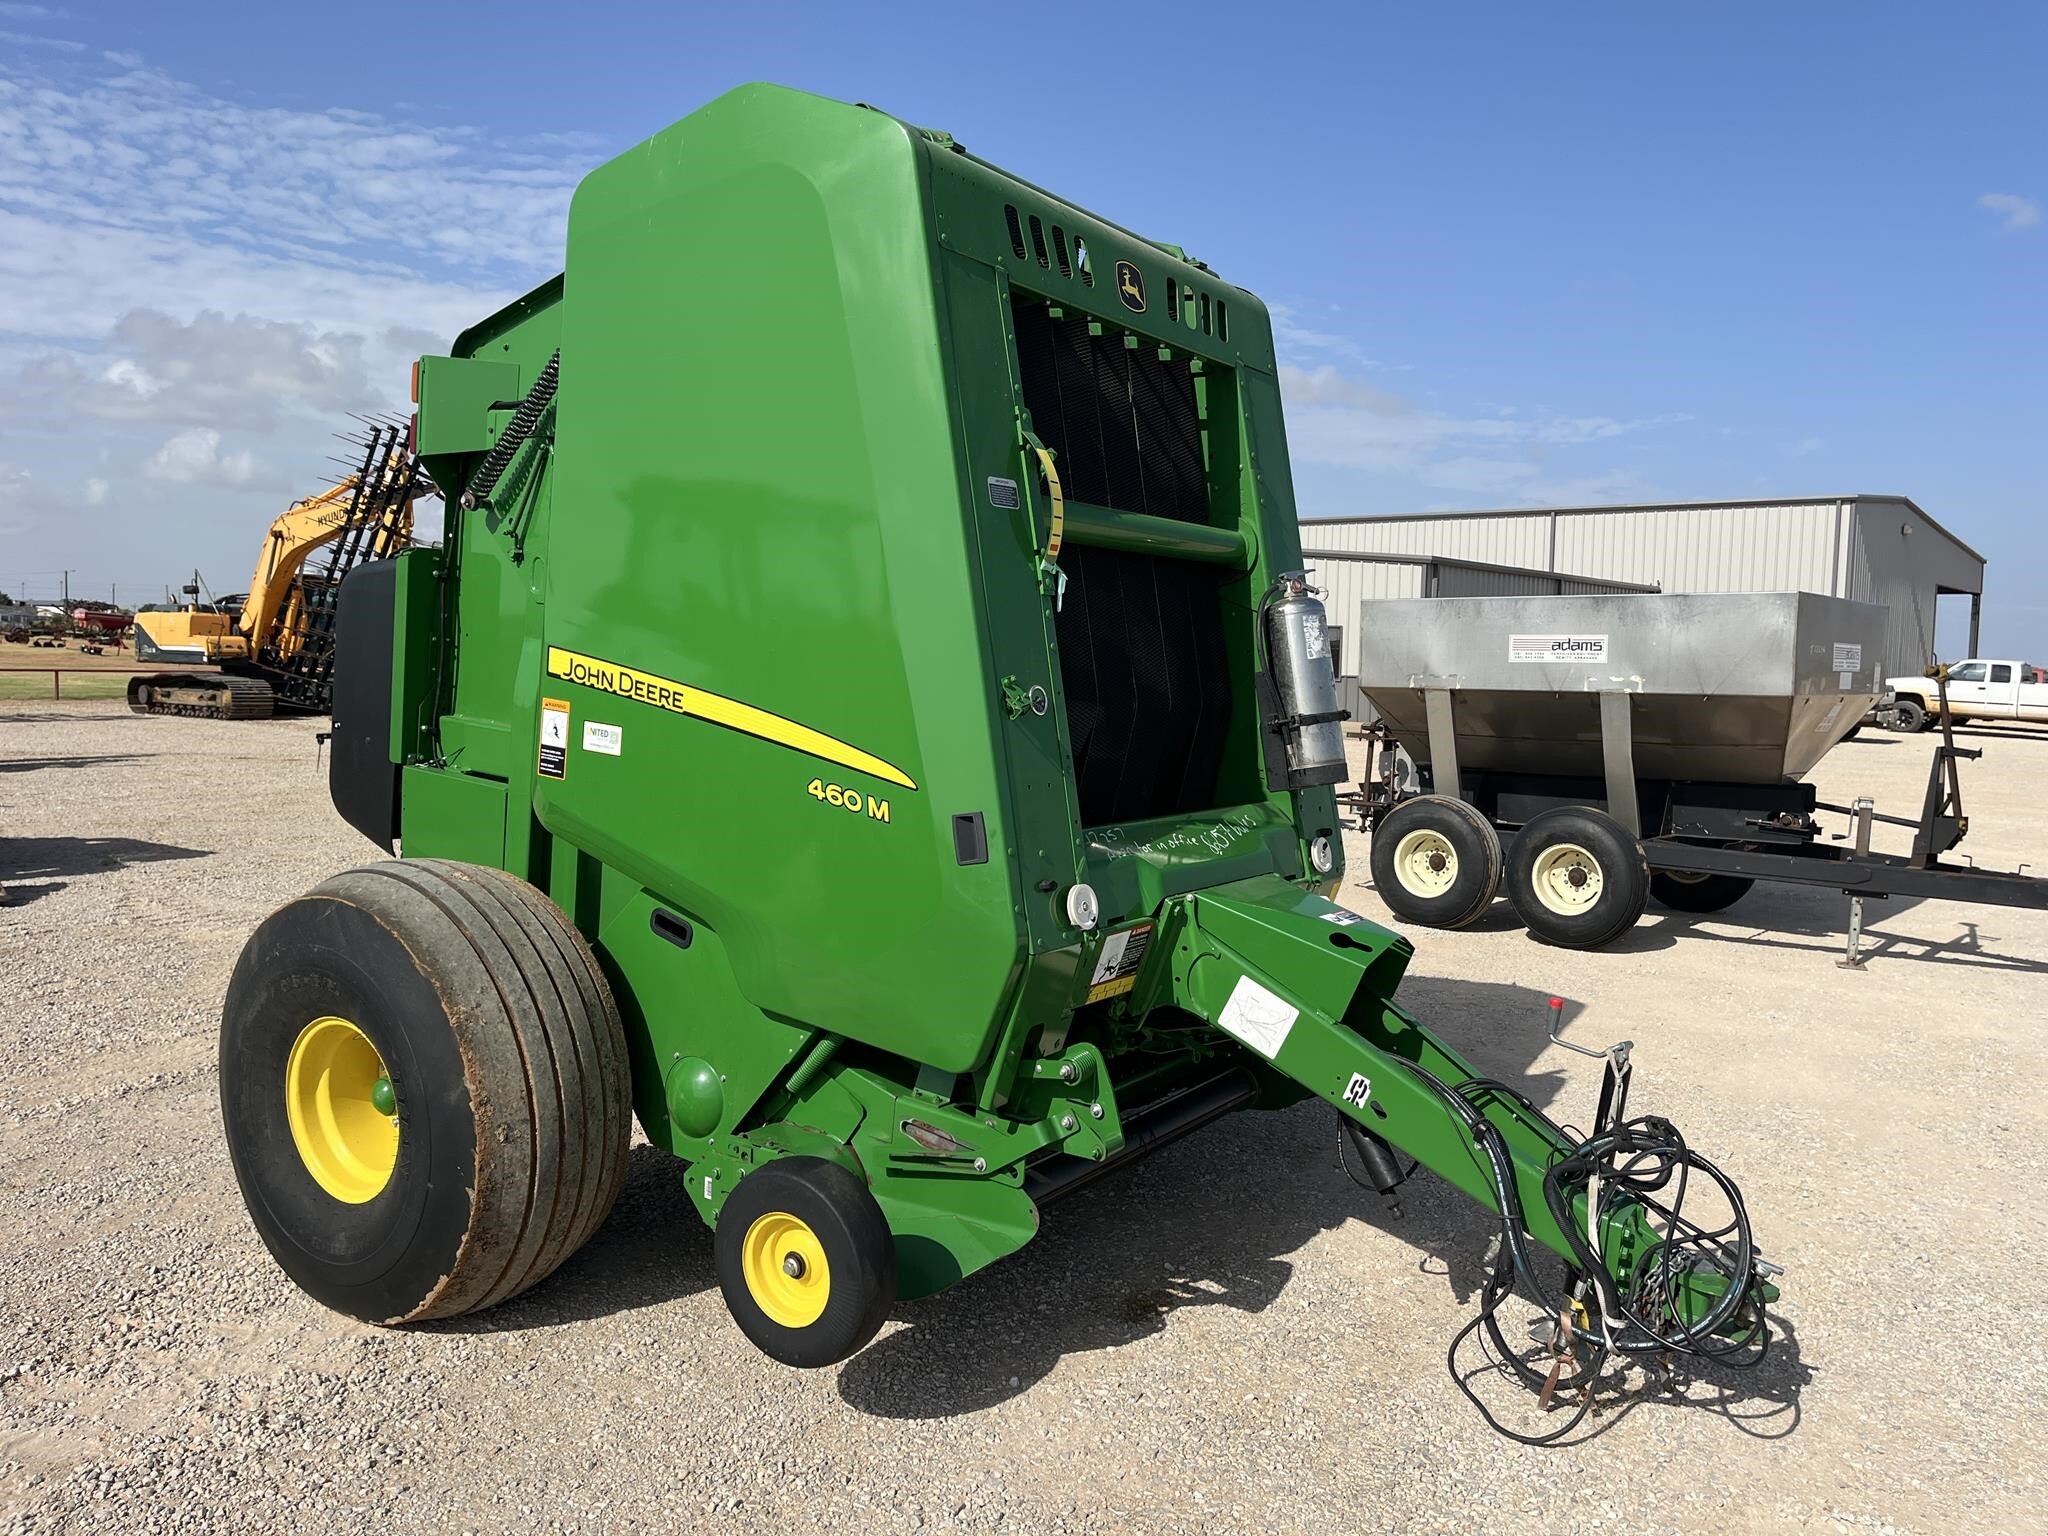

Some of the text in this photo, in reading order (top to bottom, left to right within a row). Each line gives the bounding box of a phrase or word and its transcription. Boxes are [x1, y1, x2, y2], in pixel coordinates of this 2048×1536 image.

[317, 508, 347, 527] HYUND
[1551, 637, 1603, 652] adams
[562, 657, 684, 710] JOHN DEERE
[807, 778, 891, 824] 460 M
